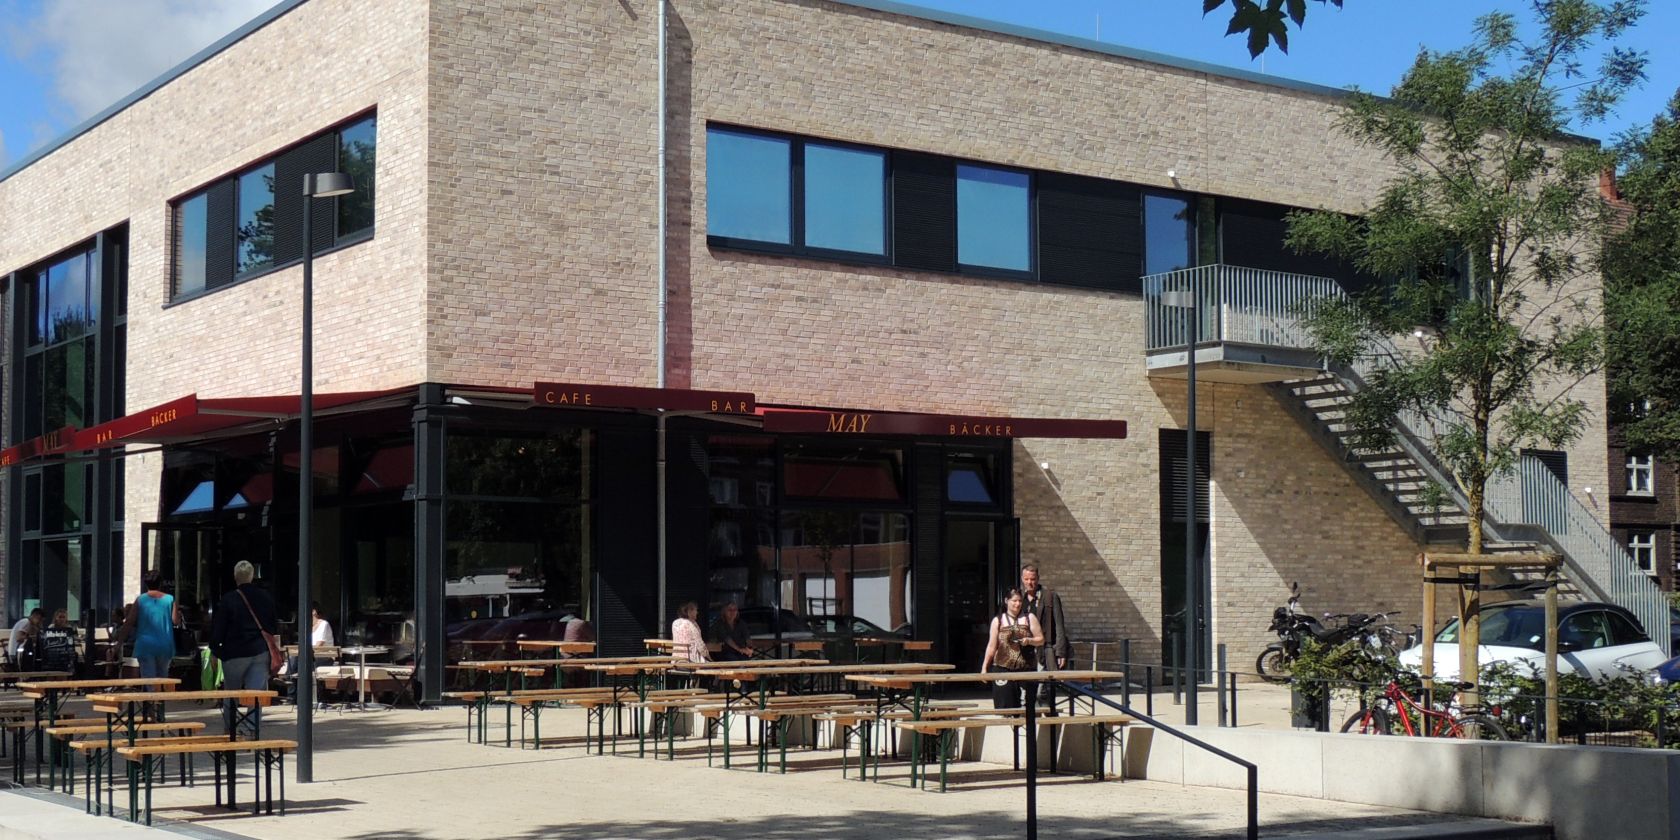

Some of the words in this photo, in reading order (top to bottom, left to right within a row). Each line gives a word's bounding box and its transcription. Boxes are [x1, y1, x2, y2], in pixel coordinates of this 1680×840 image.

[545, 391, 592, 405] CAFE
[711, 401, 748, 412] BAR
[96, 430, 113, 444] BAR
[151, 409, 177, 427] BÄCKER
[826, 413, 872, 433] MAY
[949, 422, 1012, 436] BÄCKER
